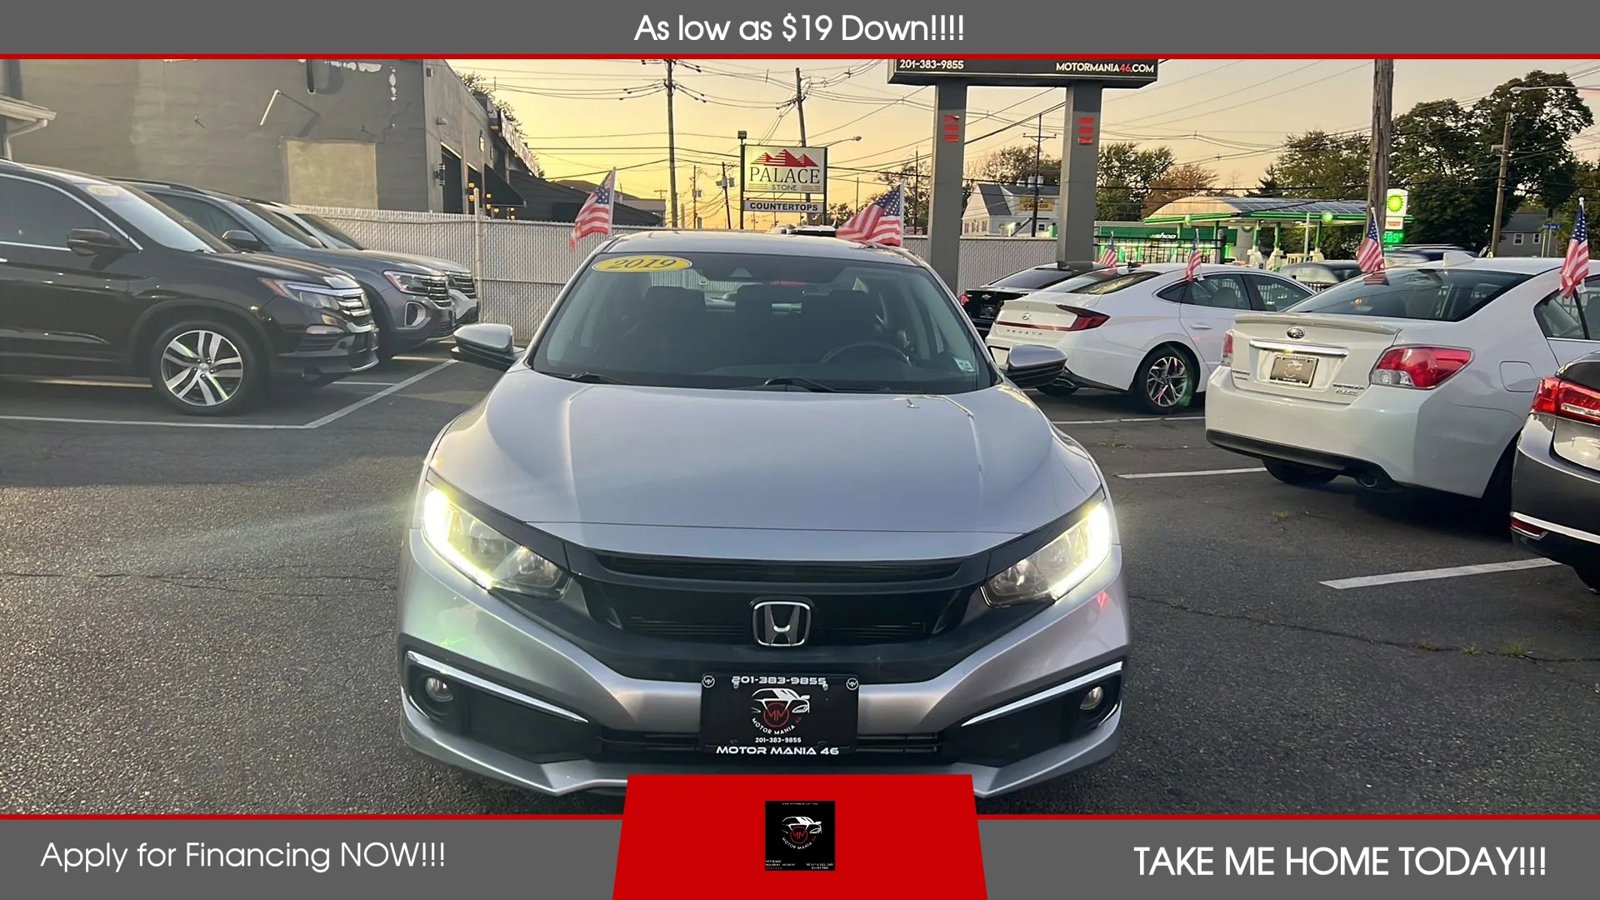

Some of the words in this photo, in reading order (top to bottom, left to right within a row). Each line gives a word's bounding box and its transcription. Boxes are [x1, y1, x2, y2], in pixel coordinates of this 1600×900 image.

[899, 59, 965, 69] 201-383-9855
[1056, 62, 1154, 73] MOTORMANIA46.COM
[749, 166, 820, 184] PALACE
[771, 183, 797, 191] STONE
[749, 202, 818, 211] COUNTERTOPS
[607, 258, 677, 269] 2019
[731, 675, 828, 686] 201-383-9855
[751, 717, 773, 735] MOTOR
[773, 724, 796, 736] MANIA
[715, 746, 768, 755] MOTOR
[770, 747, 817, 756] MANIA
[819, 747, 840, 755] 46
